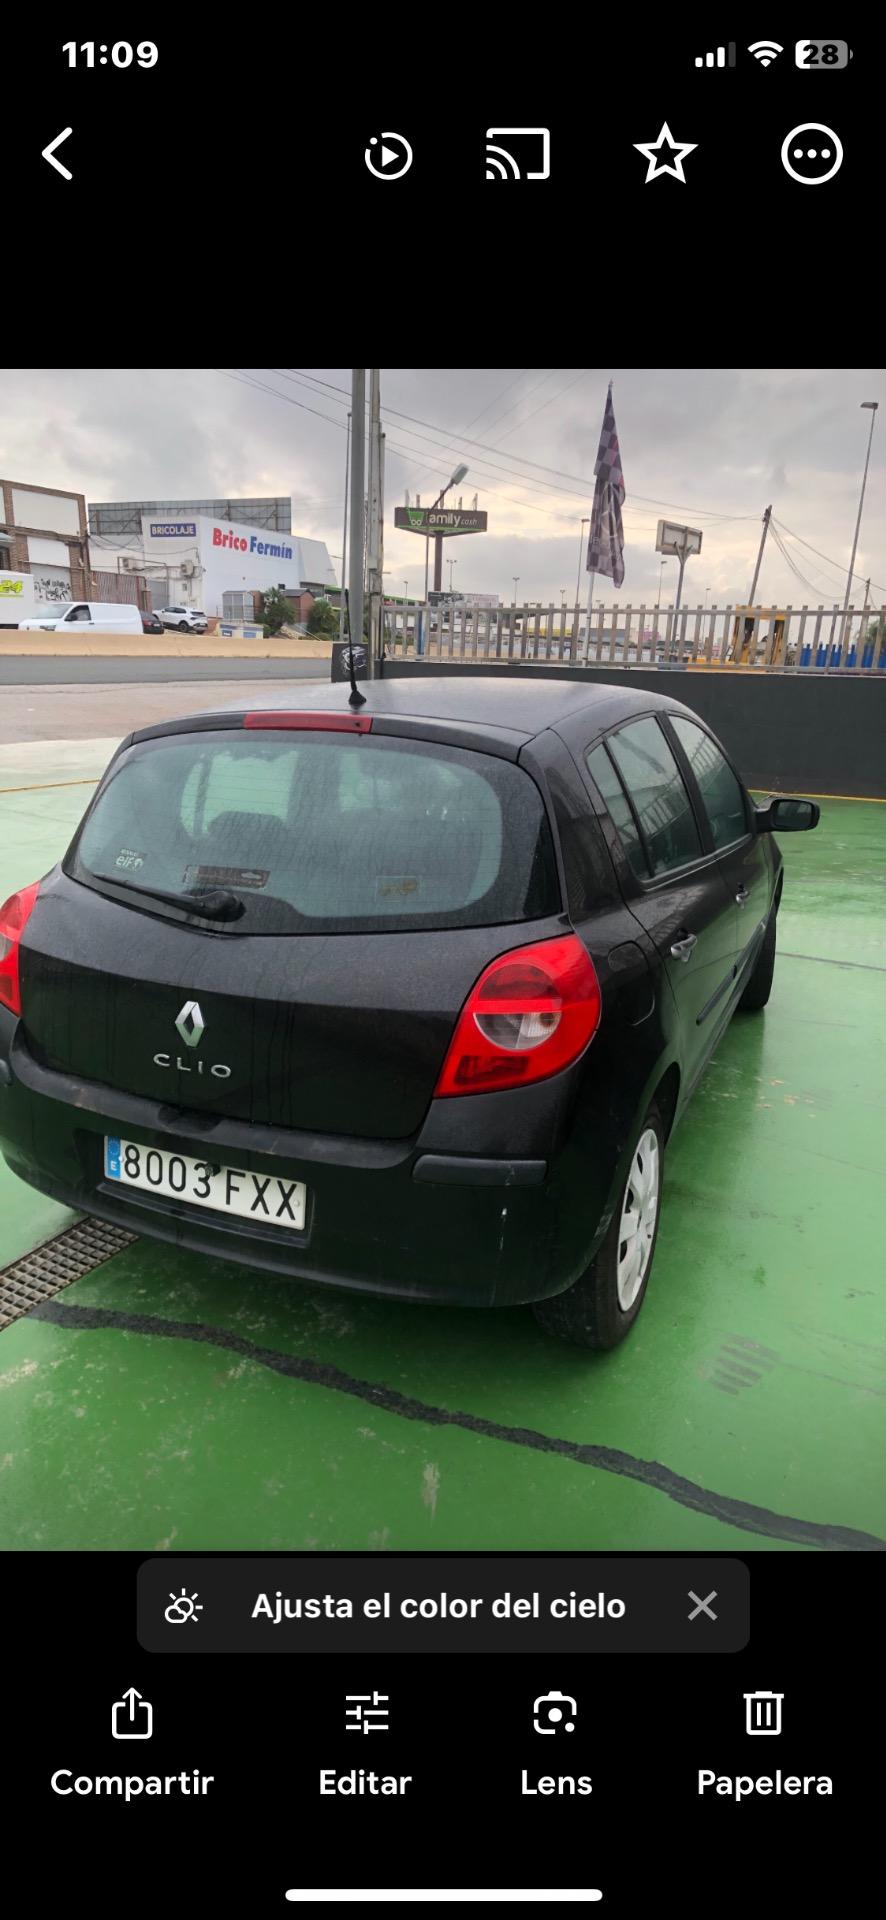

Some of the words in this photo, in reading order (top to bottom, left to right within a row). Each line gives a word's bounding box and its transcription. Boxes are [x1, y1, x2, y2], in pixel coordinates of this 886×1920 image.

[425, 512, 461, 527] amily
[151, 525, 194, 536] BRICOLAJE
[212, 528, 248, 552] Brico
[250, 536, 293, 559] Fermín
[153, 1053, 232, 1078] CLIO
[110, 1160, 118, 1172] E
[124, 1144, 211, 1199] 8003
[226, 1169, 298, 1221] FXX
